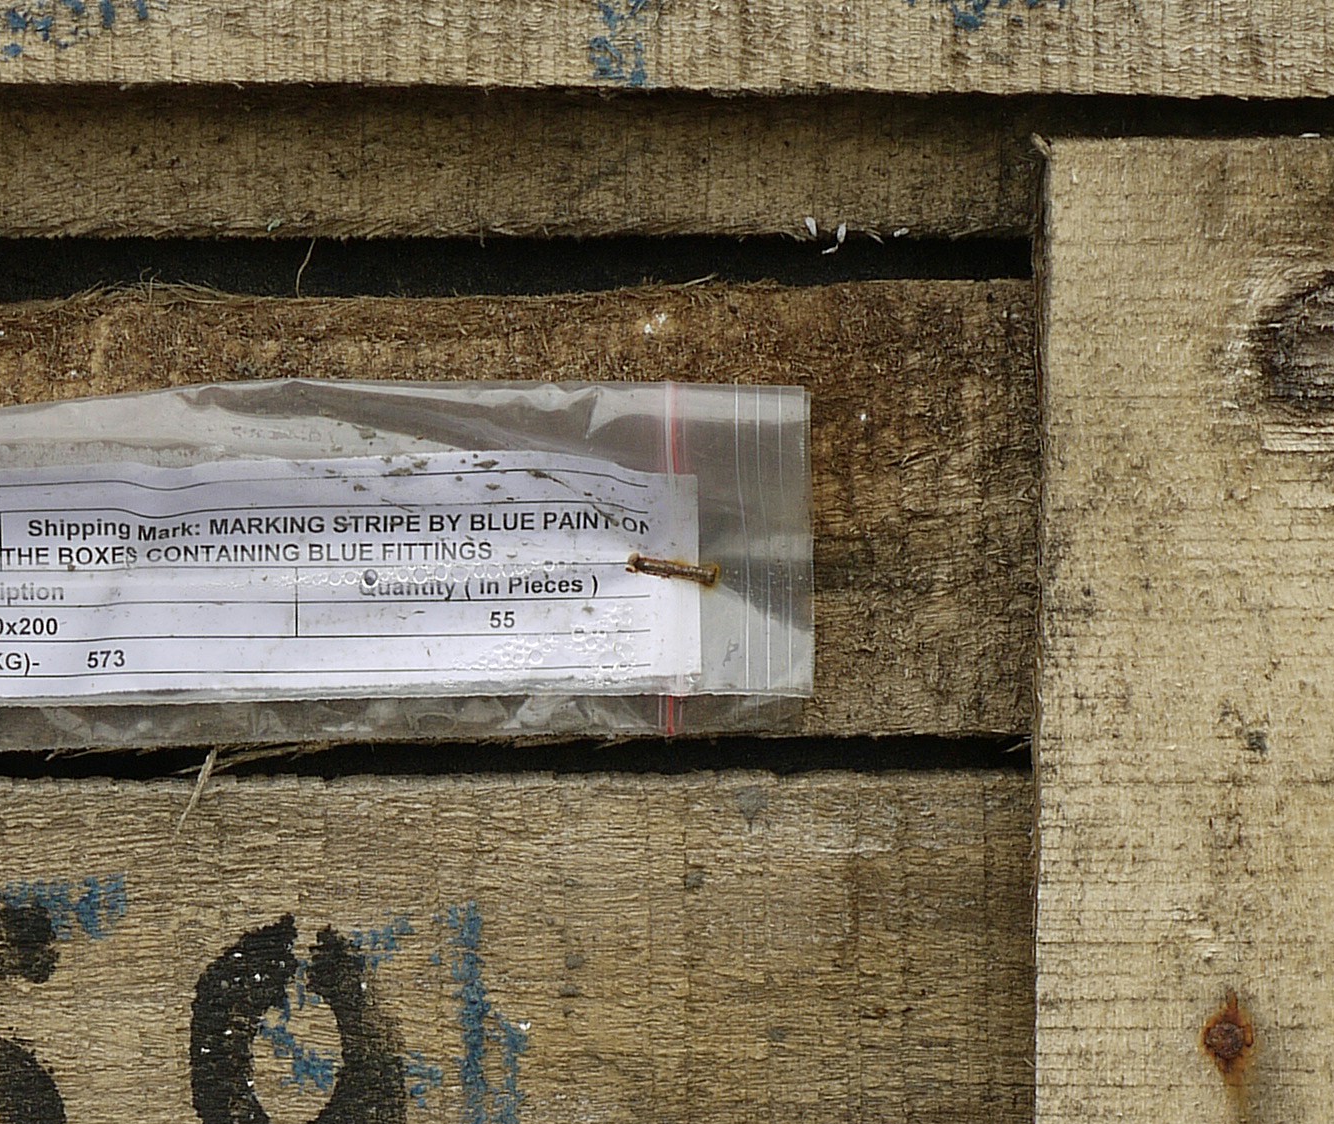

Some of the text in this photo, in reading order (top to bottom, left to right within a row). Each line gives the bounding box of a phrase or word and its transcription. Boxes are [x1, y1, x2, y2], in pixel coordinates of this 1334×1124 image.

[27, 518, 131, 541] Shipping
[137, 521, 201, 541] Mark:
[209, 516, 326, 535] MARKING
[332, 514, 422, 533] STRIPE
[429, 514, 462, 532] BY
[469, 512, 535, 531] BLUE
[1, 541, 493, 566] THE BOXES CONTAINING BLUE FITTINGS
[358, 576, 456, 601] Quantity
[508, 575, 584, 595] Pieces
[489, 611, 516, 629] 55
[86, 649, 126, 669] 573
